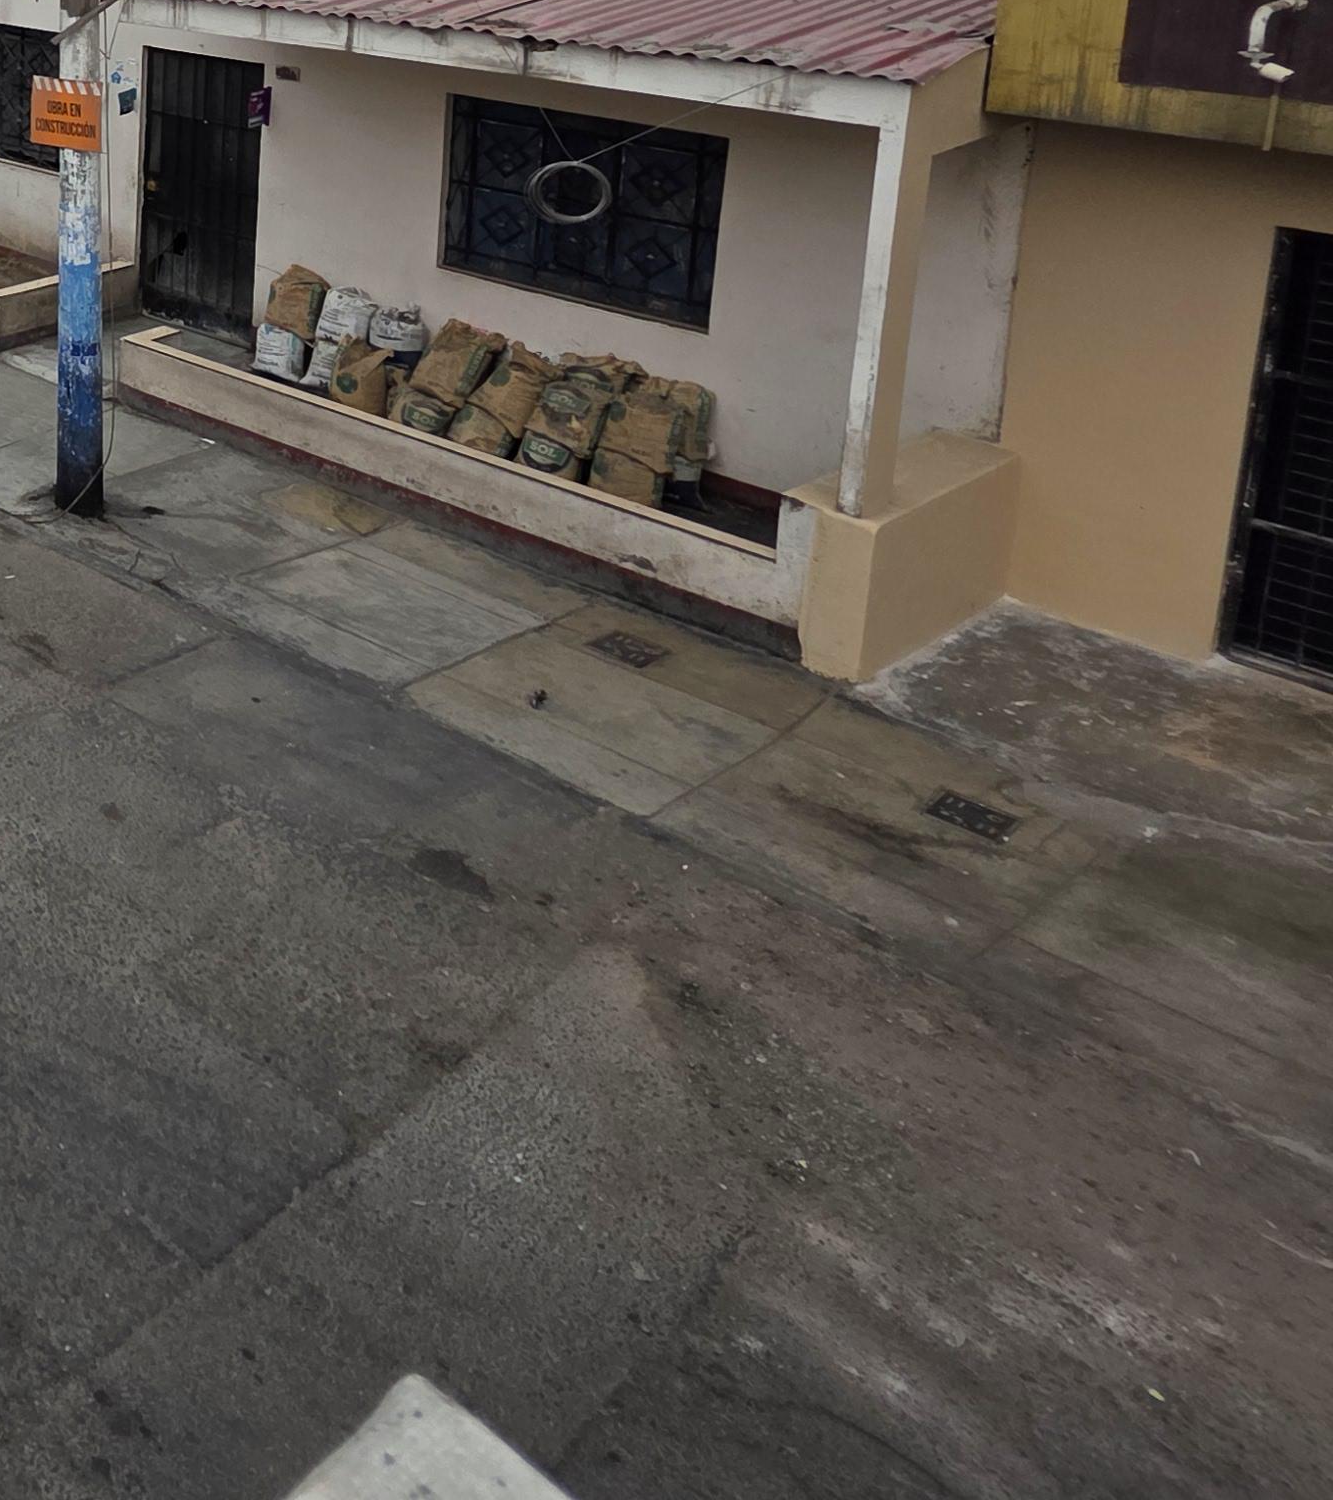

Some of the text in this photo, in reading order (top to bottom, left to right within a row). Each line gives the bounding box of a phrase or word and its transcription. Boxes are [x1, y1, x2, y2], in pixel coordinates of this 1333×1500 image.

[47, 101, 81, 117] OBRA EN
[35, 118, 96, 138] CONSTRUCCIÓN
[549, 393, 577, 407] SOL
[413, 411, 437, 426] SOL
[529, 440, 557, 458] SOL
